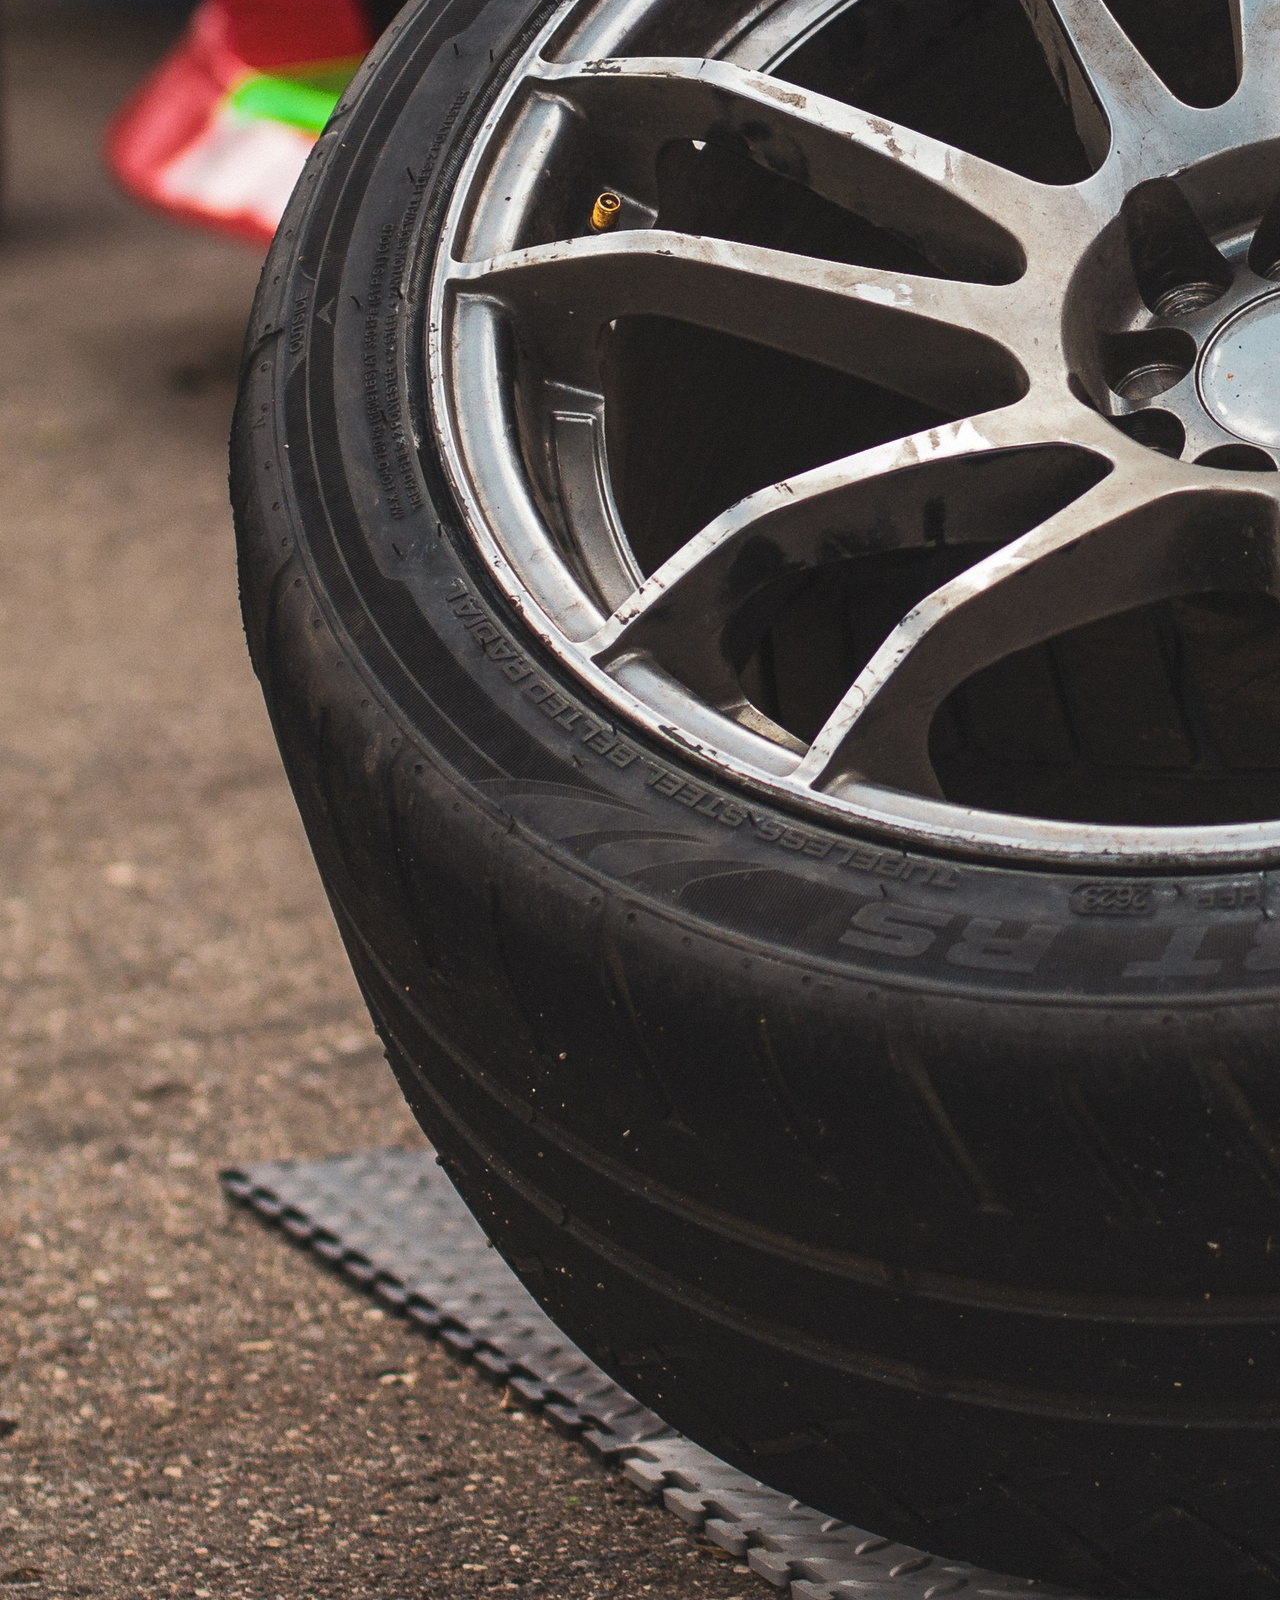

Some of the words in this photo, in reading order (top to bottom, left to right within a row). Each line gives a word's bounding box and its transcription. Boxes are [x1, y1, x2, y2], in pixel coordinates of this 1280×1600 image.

[375, 222, 397, 252] COLD
[287, 290, 310, 353] OUTSIDE
[363, 350, 376, 366] AT
[384, 365, 402, 428] POLYESTER
[376, 458, 395, 491] LOAD
[401, 471, 424, 510] TREAD
[434, 573, 534, 685] RADIAL
[521, 677, 641, 771] BELTED
[630, 759, 751, 829] STEEL
[752, 818, 964, 889] TUBELESS
[837, 901, 1063, 975] RS
